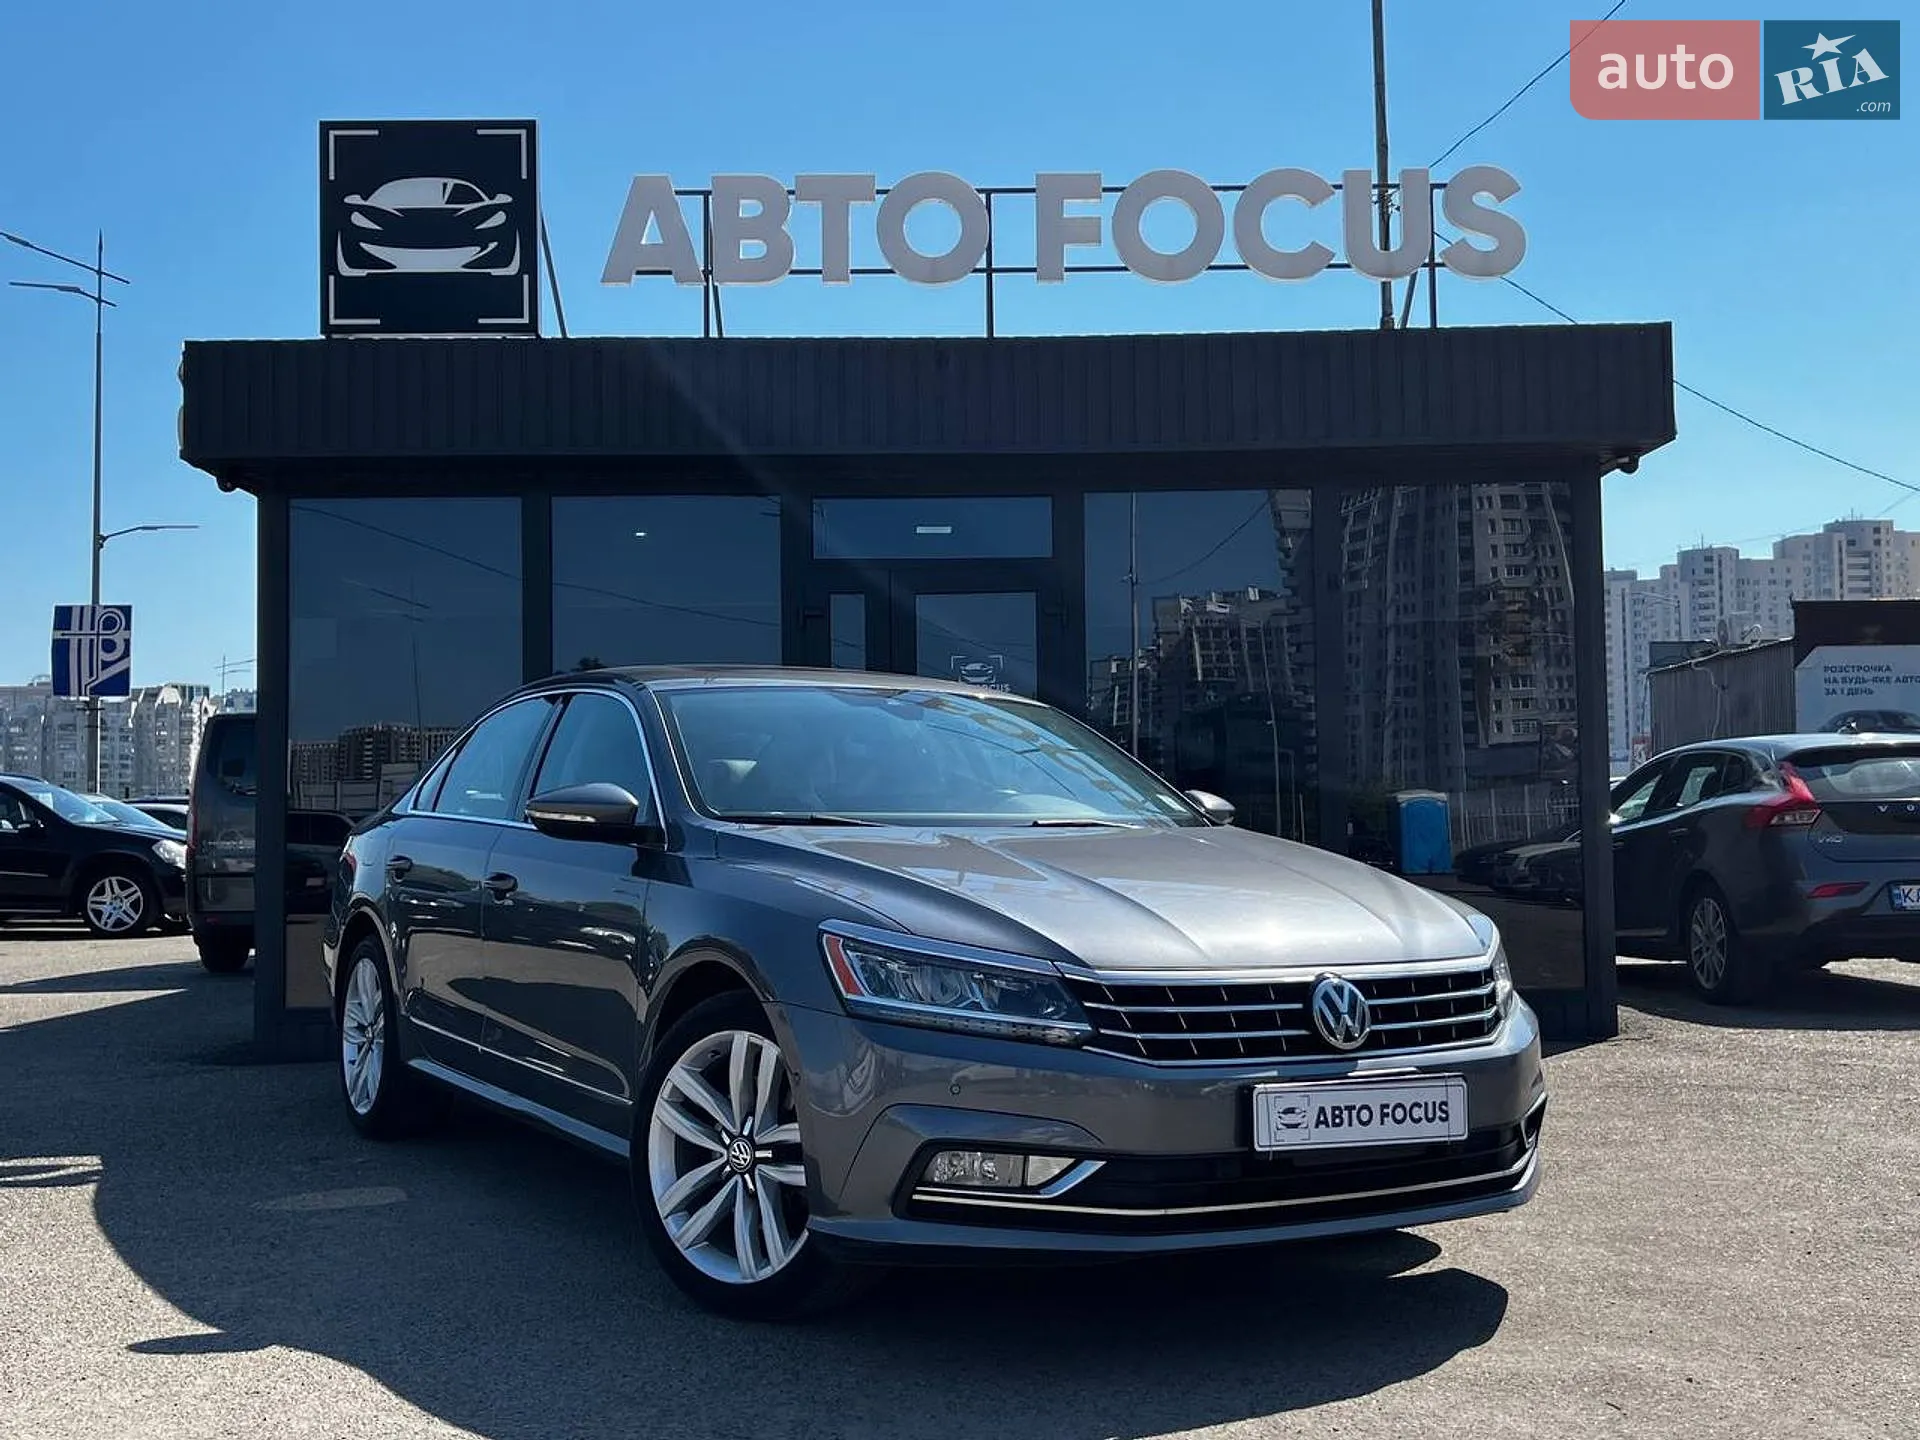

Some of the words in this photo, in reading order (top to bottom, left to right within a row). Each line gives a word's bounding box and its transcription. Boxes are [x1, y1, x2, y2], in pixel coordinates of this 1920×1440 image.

[600, 171, 990, 287] АВТО
[1035, 166, 1527, 283] FOCUS
[1823, 665, 1892, 674] РОЗСТРОЧКА
[1823, 676, 1839, 685] НА
[1840, 676, 1892, 686] БУДЬ-ЯКЕ
[1824, 687, 1837, 697] ЗА
[1846, 687, 1875, 697] ДЕНЬ
[1314, 1104, 1374, 1129] АВТО
[1380, 1101, 1449, 1126] FOCUS
